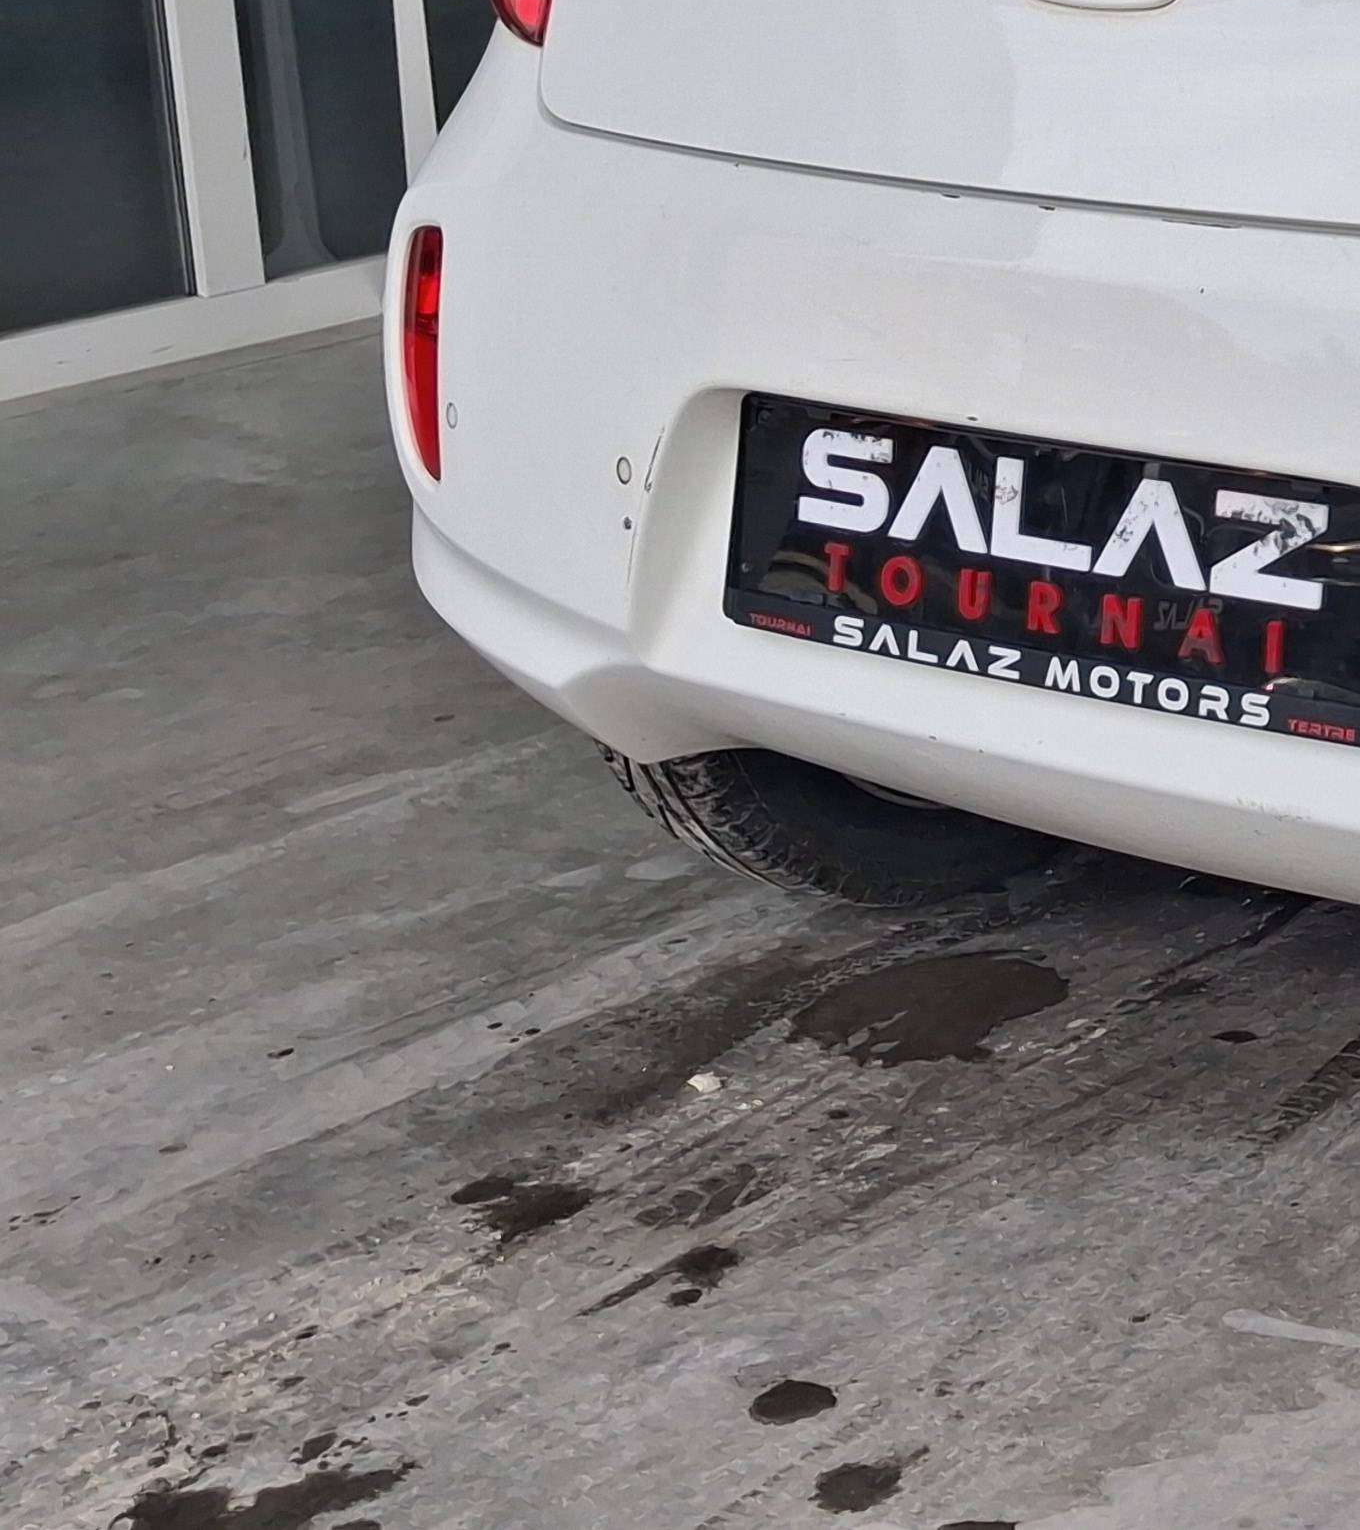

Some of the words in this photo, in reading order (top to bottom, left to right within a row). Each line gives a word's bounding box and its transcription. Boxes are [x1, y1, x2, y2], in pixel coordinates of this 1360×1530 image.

[798, 427, 1330, 610] SALAZ
[823, 543, 1285, 674] TOURNAI
[832, 615, 1021, 680] SALAZ
[1045, 656, 1271, 727] MOTORS
